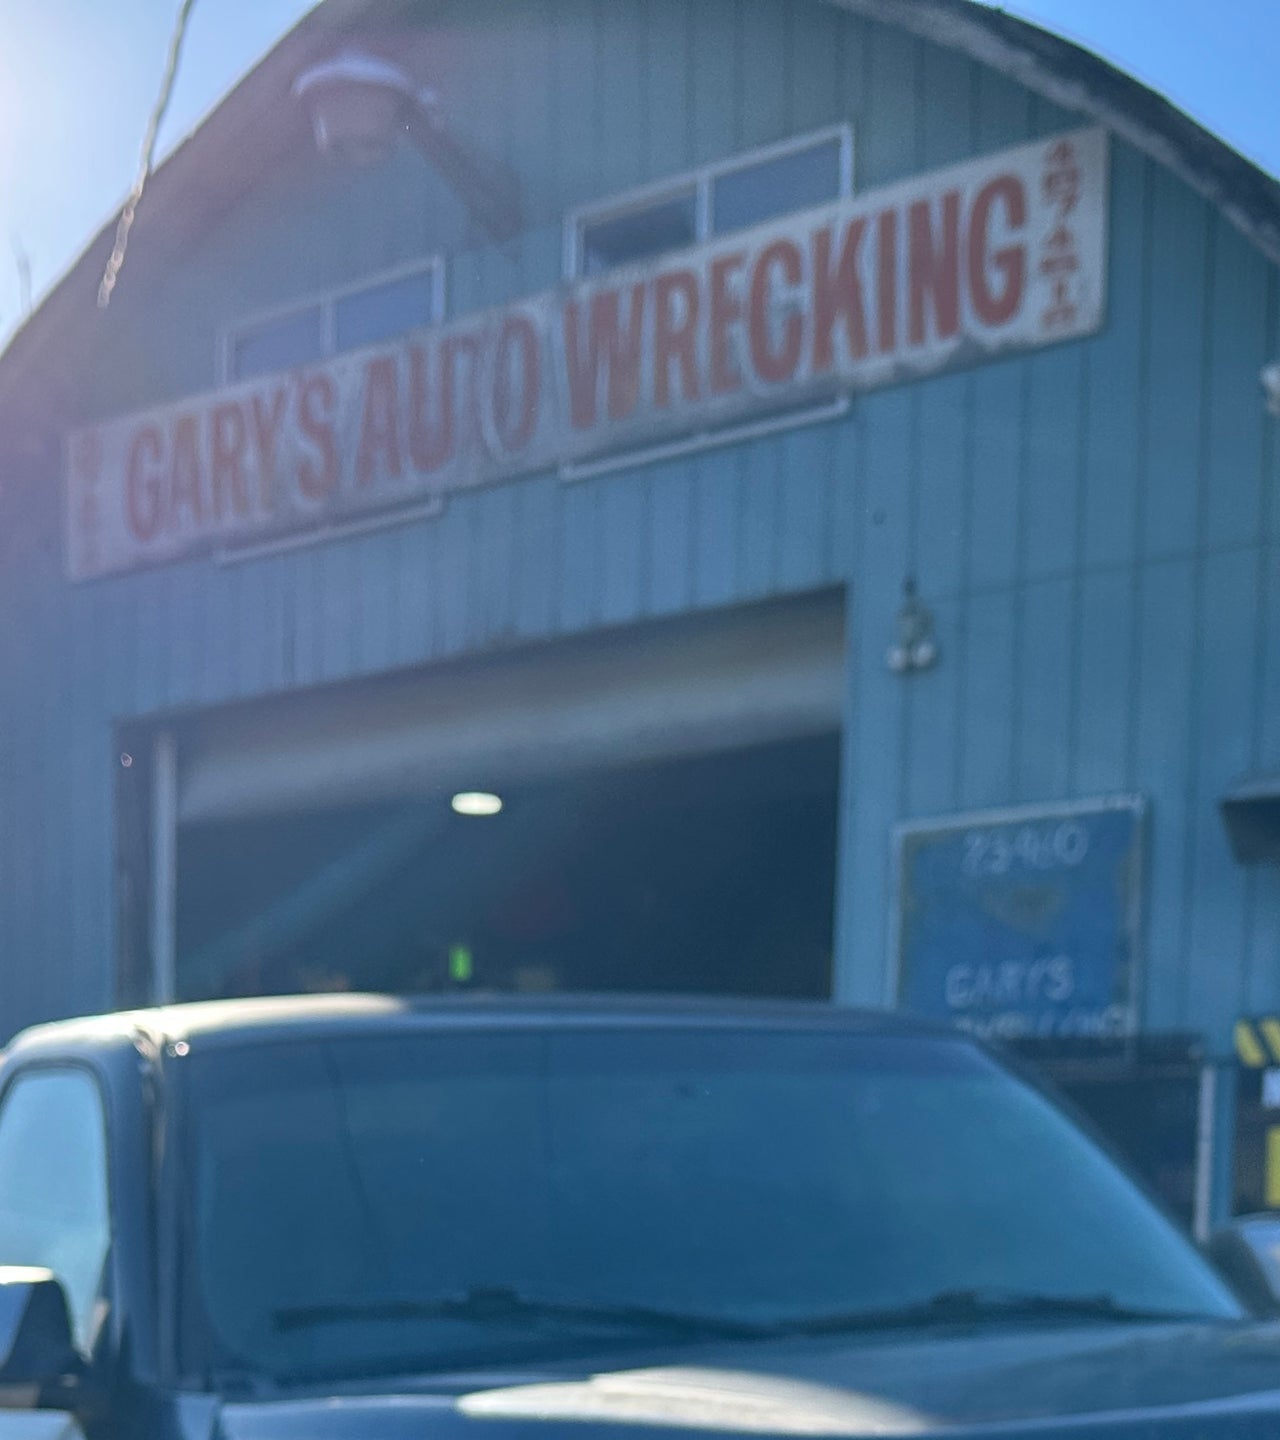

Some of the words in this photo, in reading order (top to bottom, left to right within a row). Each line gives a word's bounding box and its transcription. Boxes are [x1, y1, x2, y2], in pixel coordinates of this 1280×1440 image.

[123, 368, 340, 544] GARY'S
[352, 314, 541, 488] AUTO
[563, 172, 1028, 432] WRECKING
